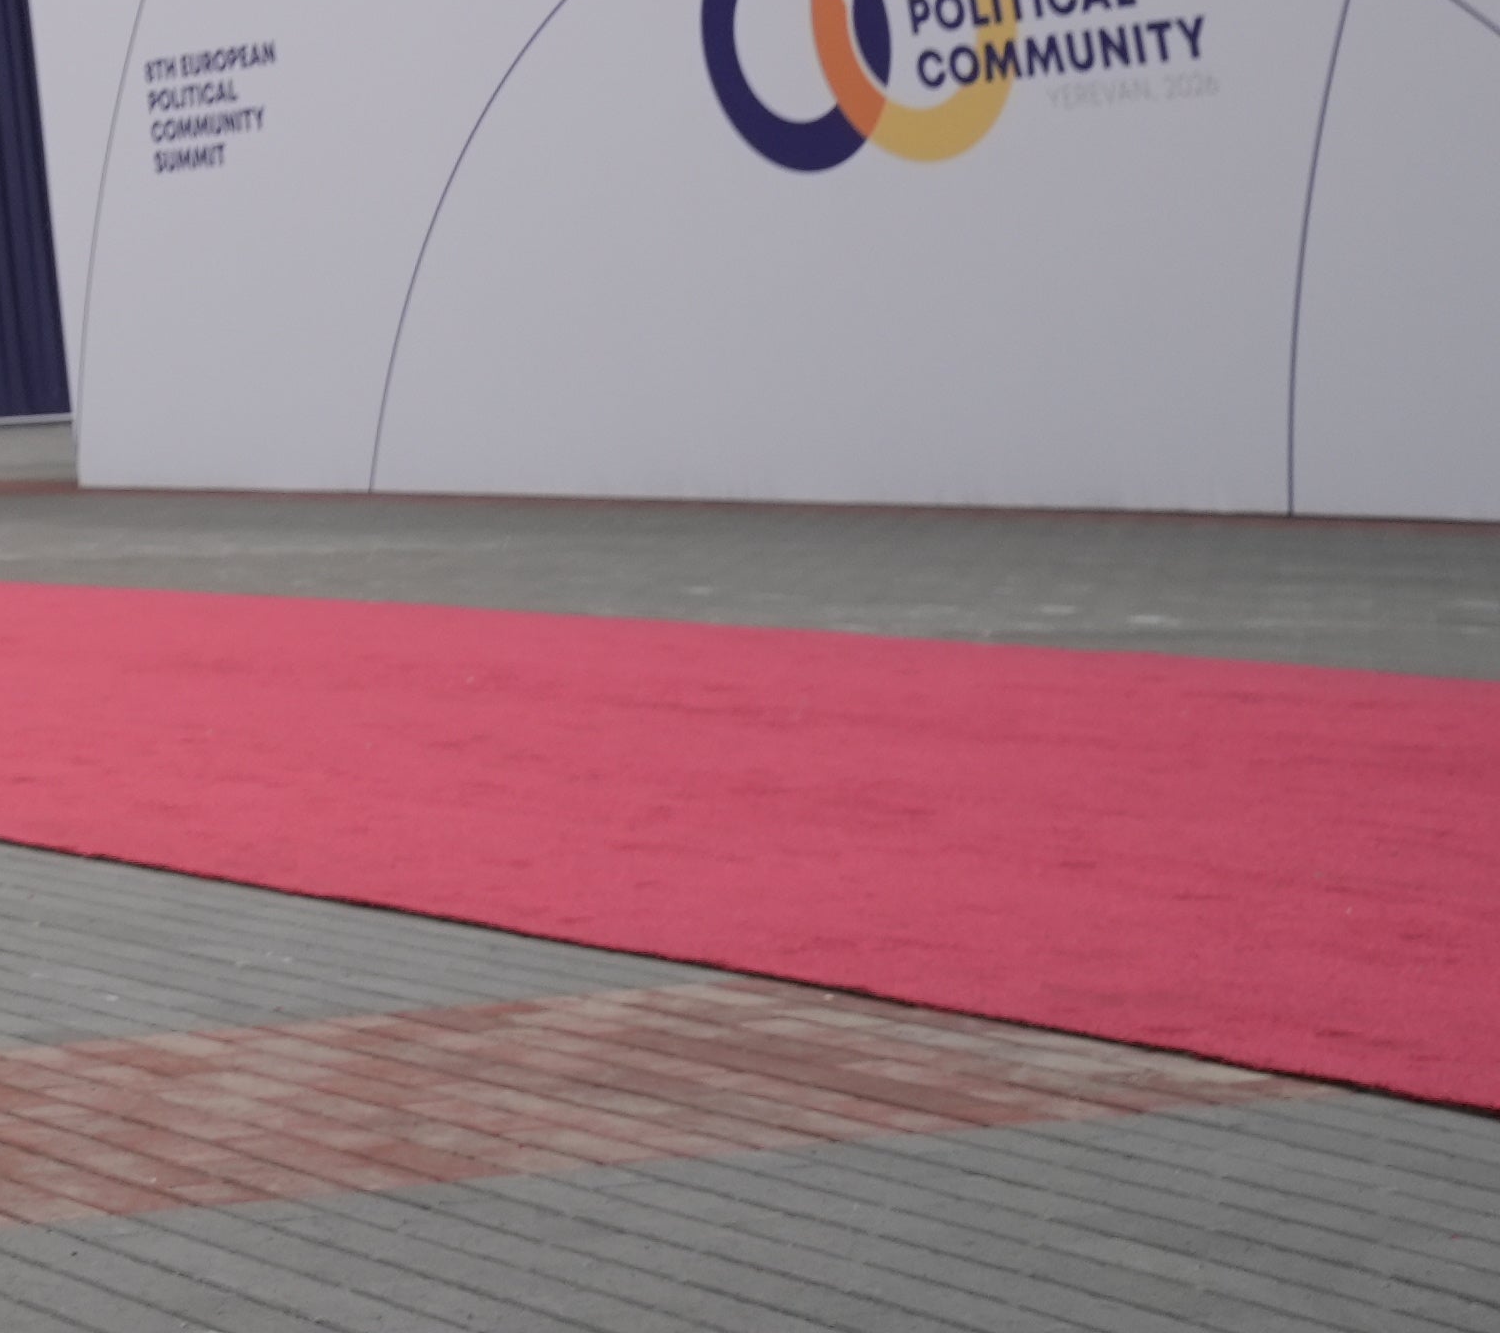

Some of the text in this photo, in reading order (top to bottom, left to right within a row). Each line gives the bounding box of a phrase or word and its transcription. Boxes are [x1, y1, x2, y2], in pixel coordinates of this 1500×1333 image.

[180, 40, 277, 78] EUROPEAN
[916, 14, 1205, 90] COMMUNITY
[148, 79, 239, 113] POLITICAL
[151, 106, 264, 143] COMMUNITY
[154, 142, 226, 174] SUMMIT
